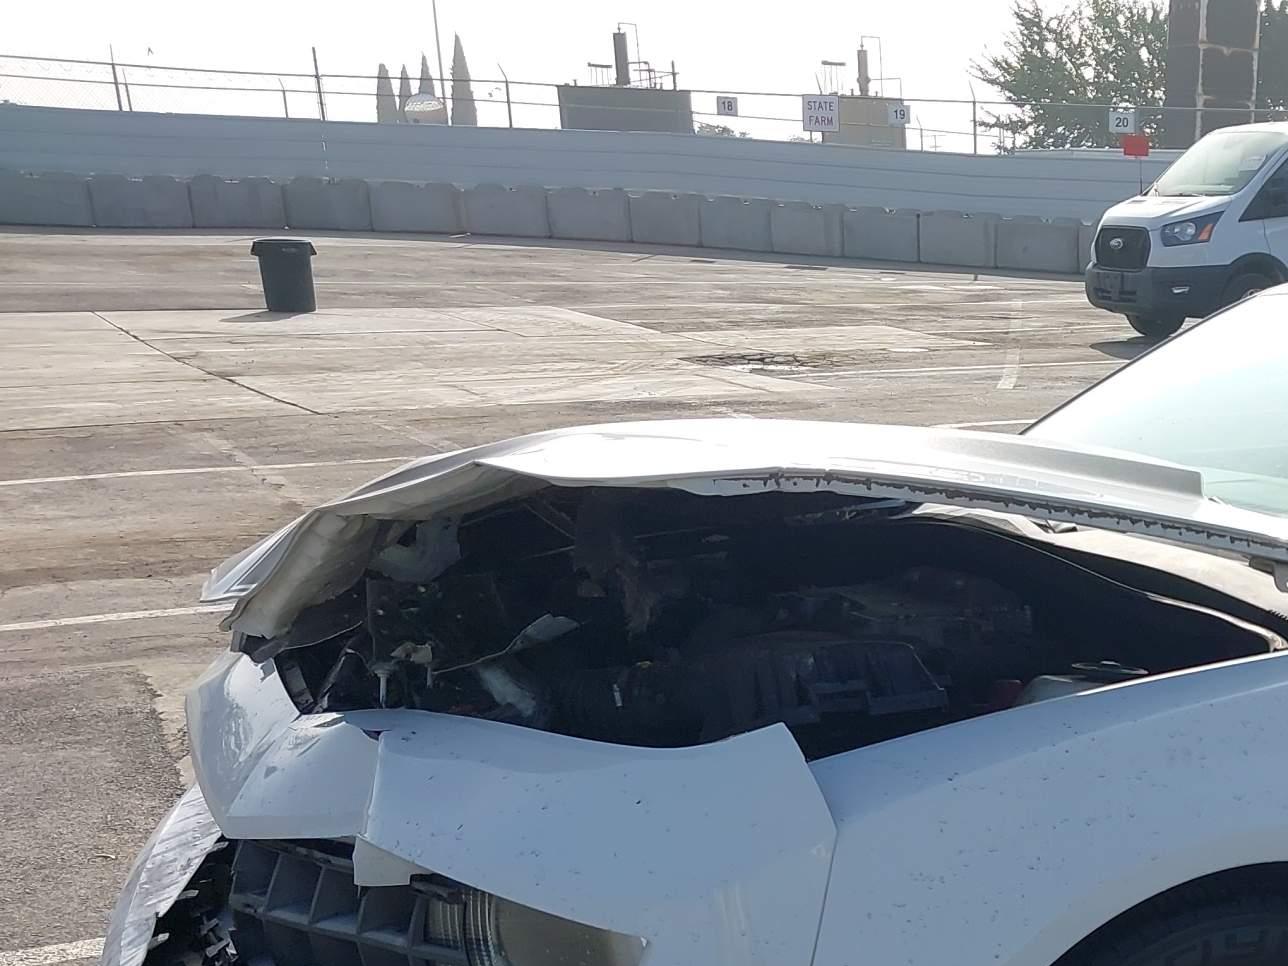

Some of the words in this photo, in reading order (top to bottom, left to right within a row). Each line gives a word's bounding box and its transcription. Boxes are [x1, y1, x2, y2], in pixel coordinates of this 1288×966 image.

[721, 100, 733, 112] 18
[807, 100, 834, 112] STATE
[893, 109, 906, 120] 19
[809, 115, 833, 127] FARM
[1115, 116, 1129, 128] 20
